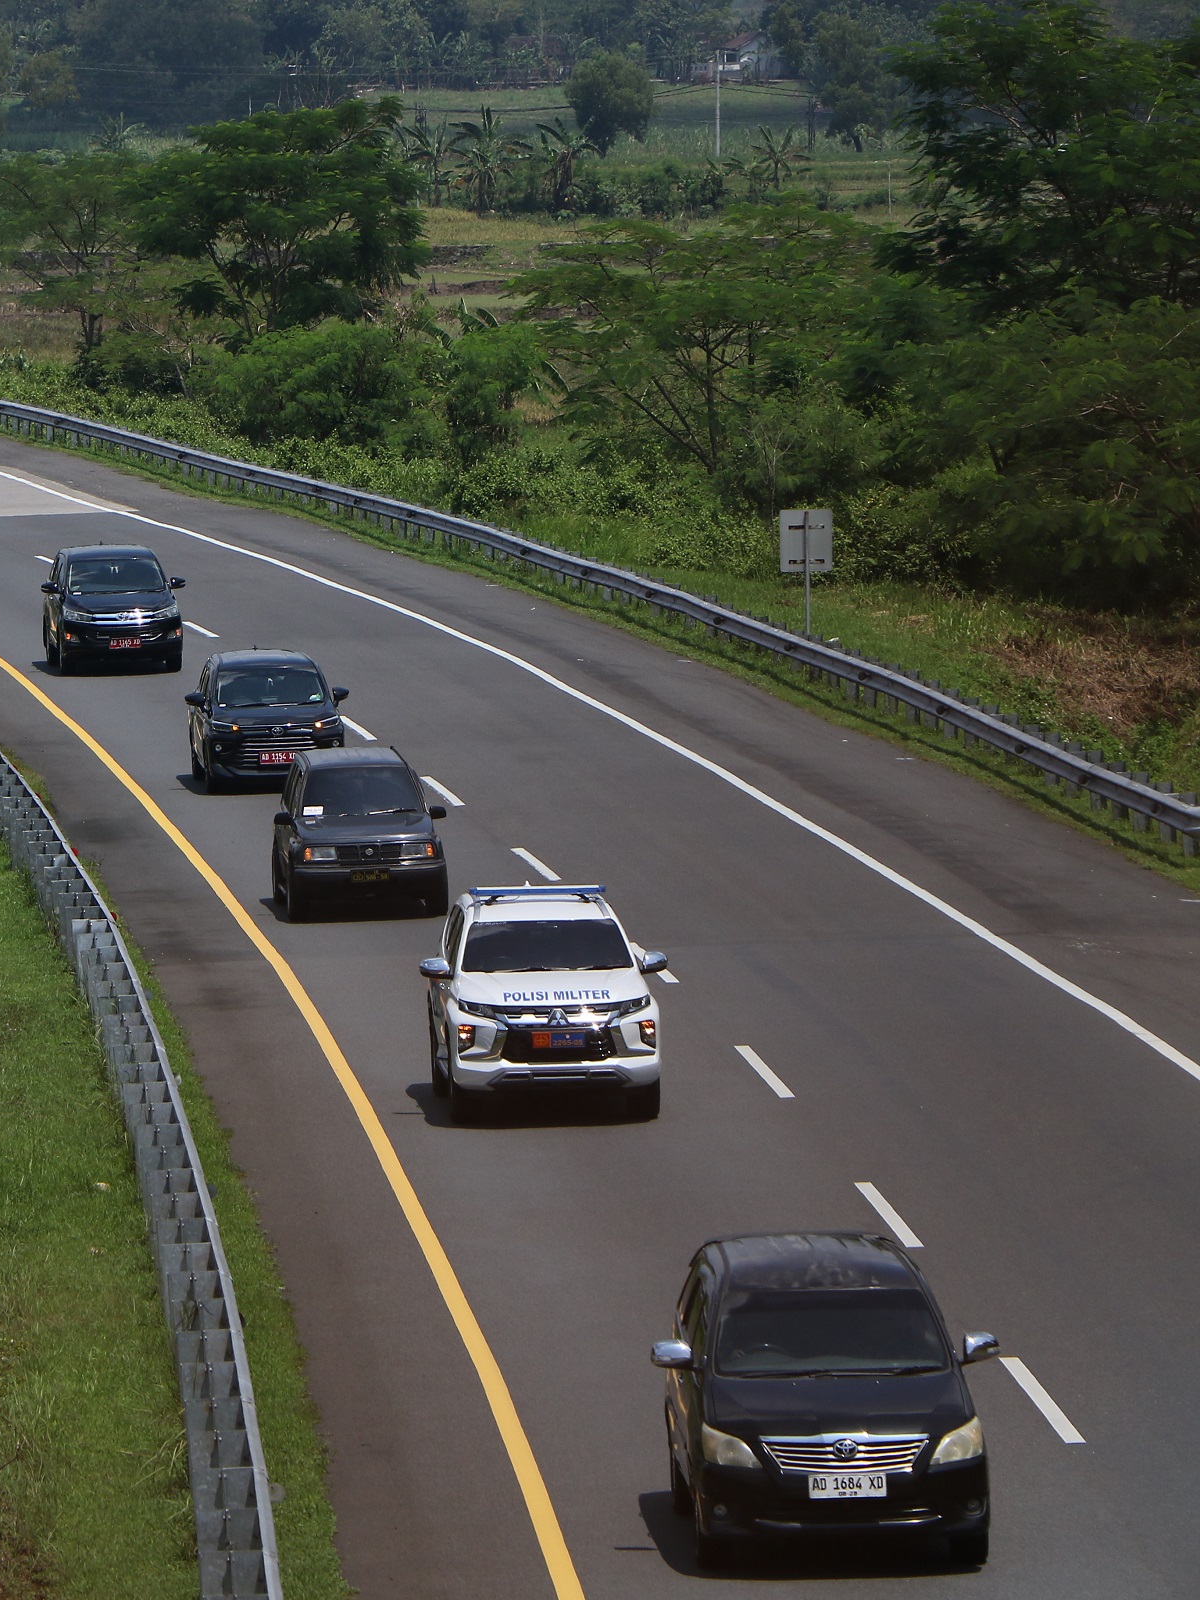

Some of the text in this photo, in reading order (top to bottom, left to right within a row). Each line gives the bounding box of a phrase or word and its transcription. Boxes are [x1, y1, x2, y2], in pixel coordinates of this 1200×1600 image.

[271, 752, 287, 760] 1154
[503, 989, 611, 1002] POLISI MILITER
[812, 1476, 884, 1491] AD 1684 XD
